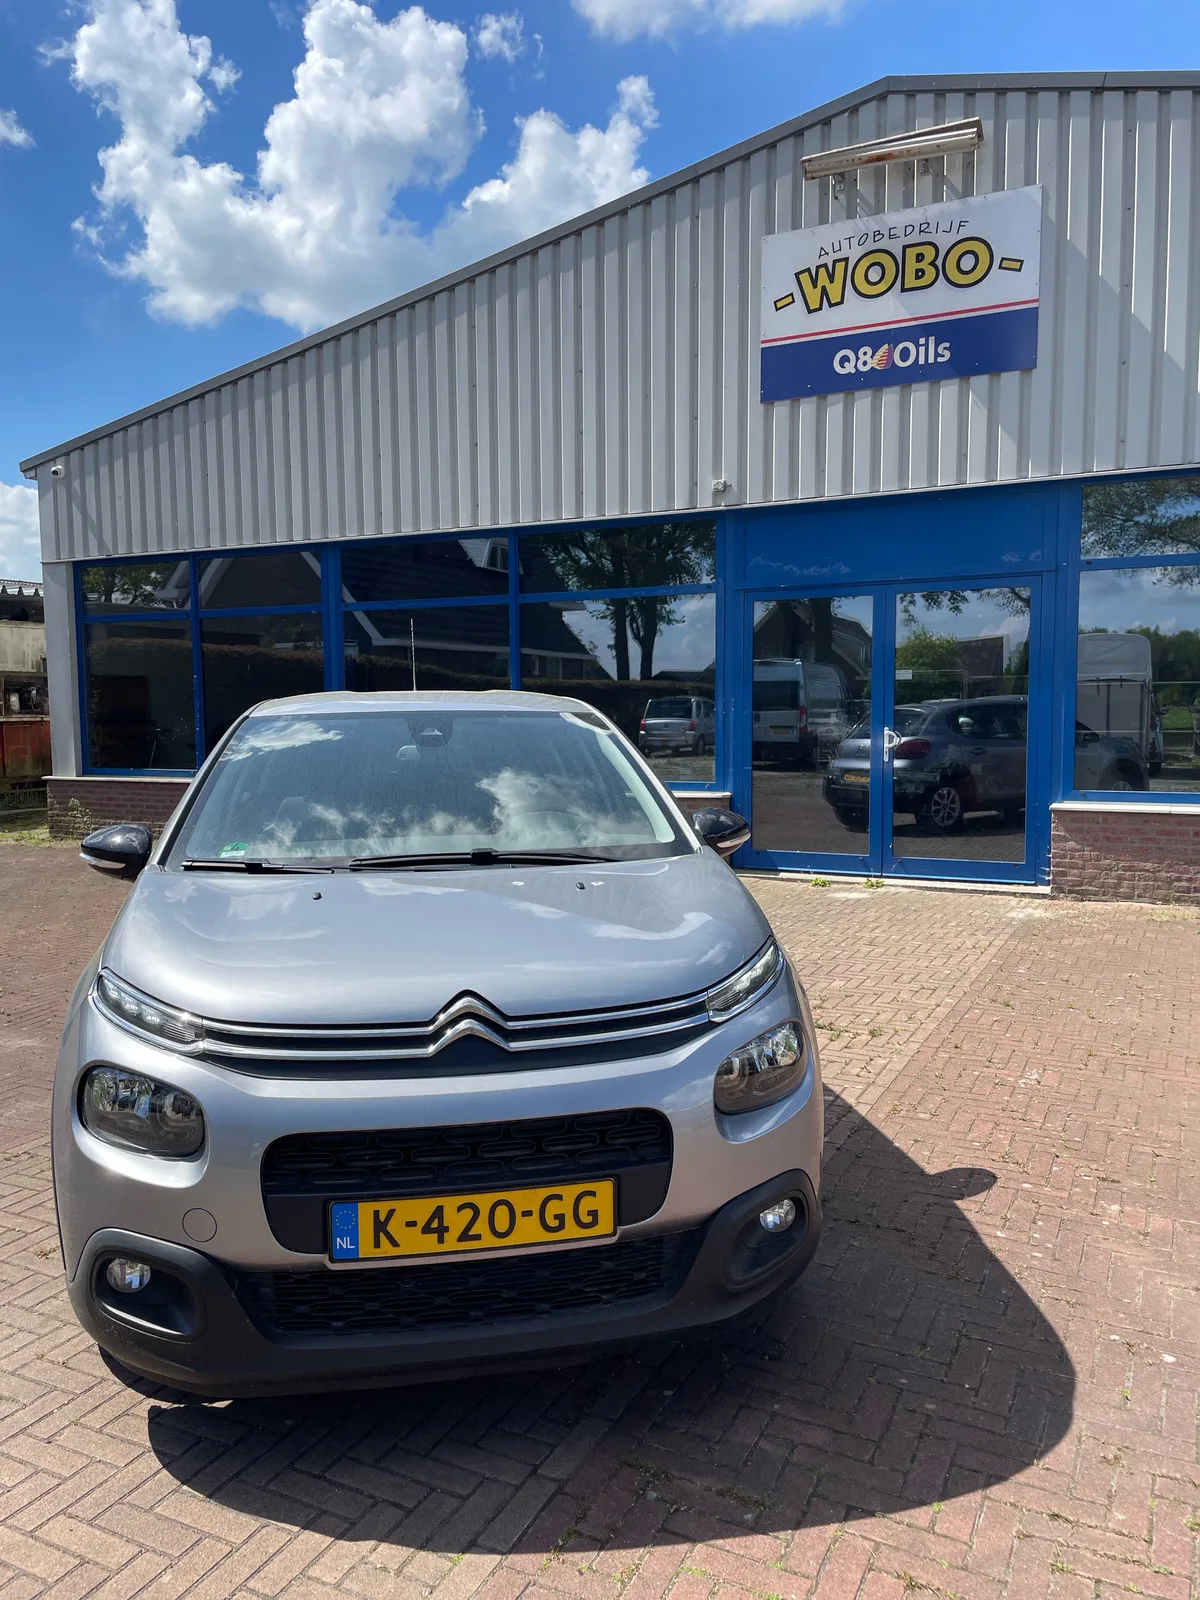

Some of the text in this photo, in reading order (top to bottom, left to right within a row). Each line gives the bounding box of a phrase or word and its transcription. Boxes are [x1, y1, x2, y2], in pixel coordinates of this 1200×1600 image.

[818, 220, 969, 259] AUTOBEDRIJF
[833, 336, 951, 375] Q8 Oils
[336, 1190, 599, 1250] NL K-420-GG
